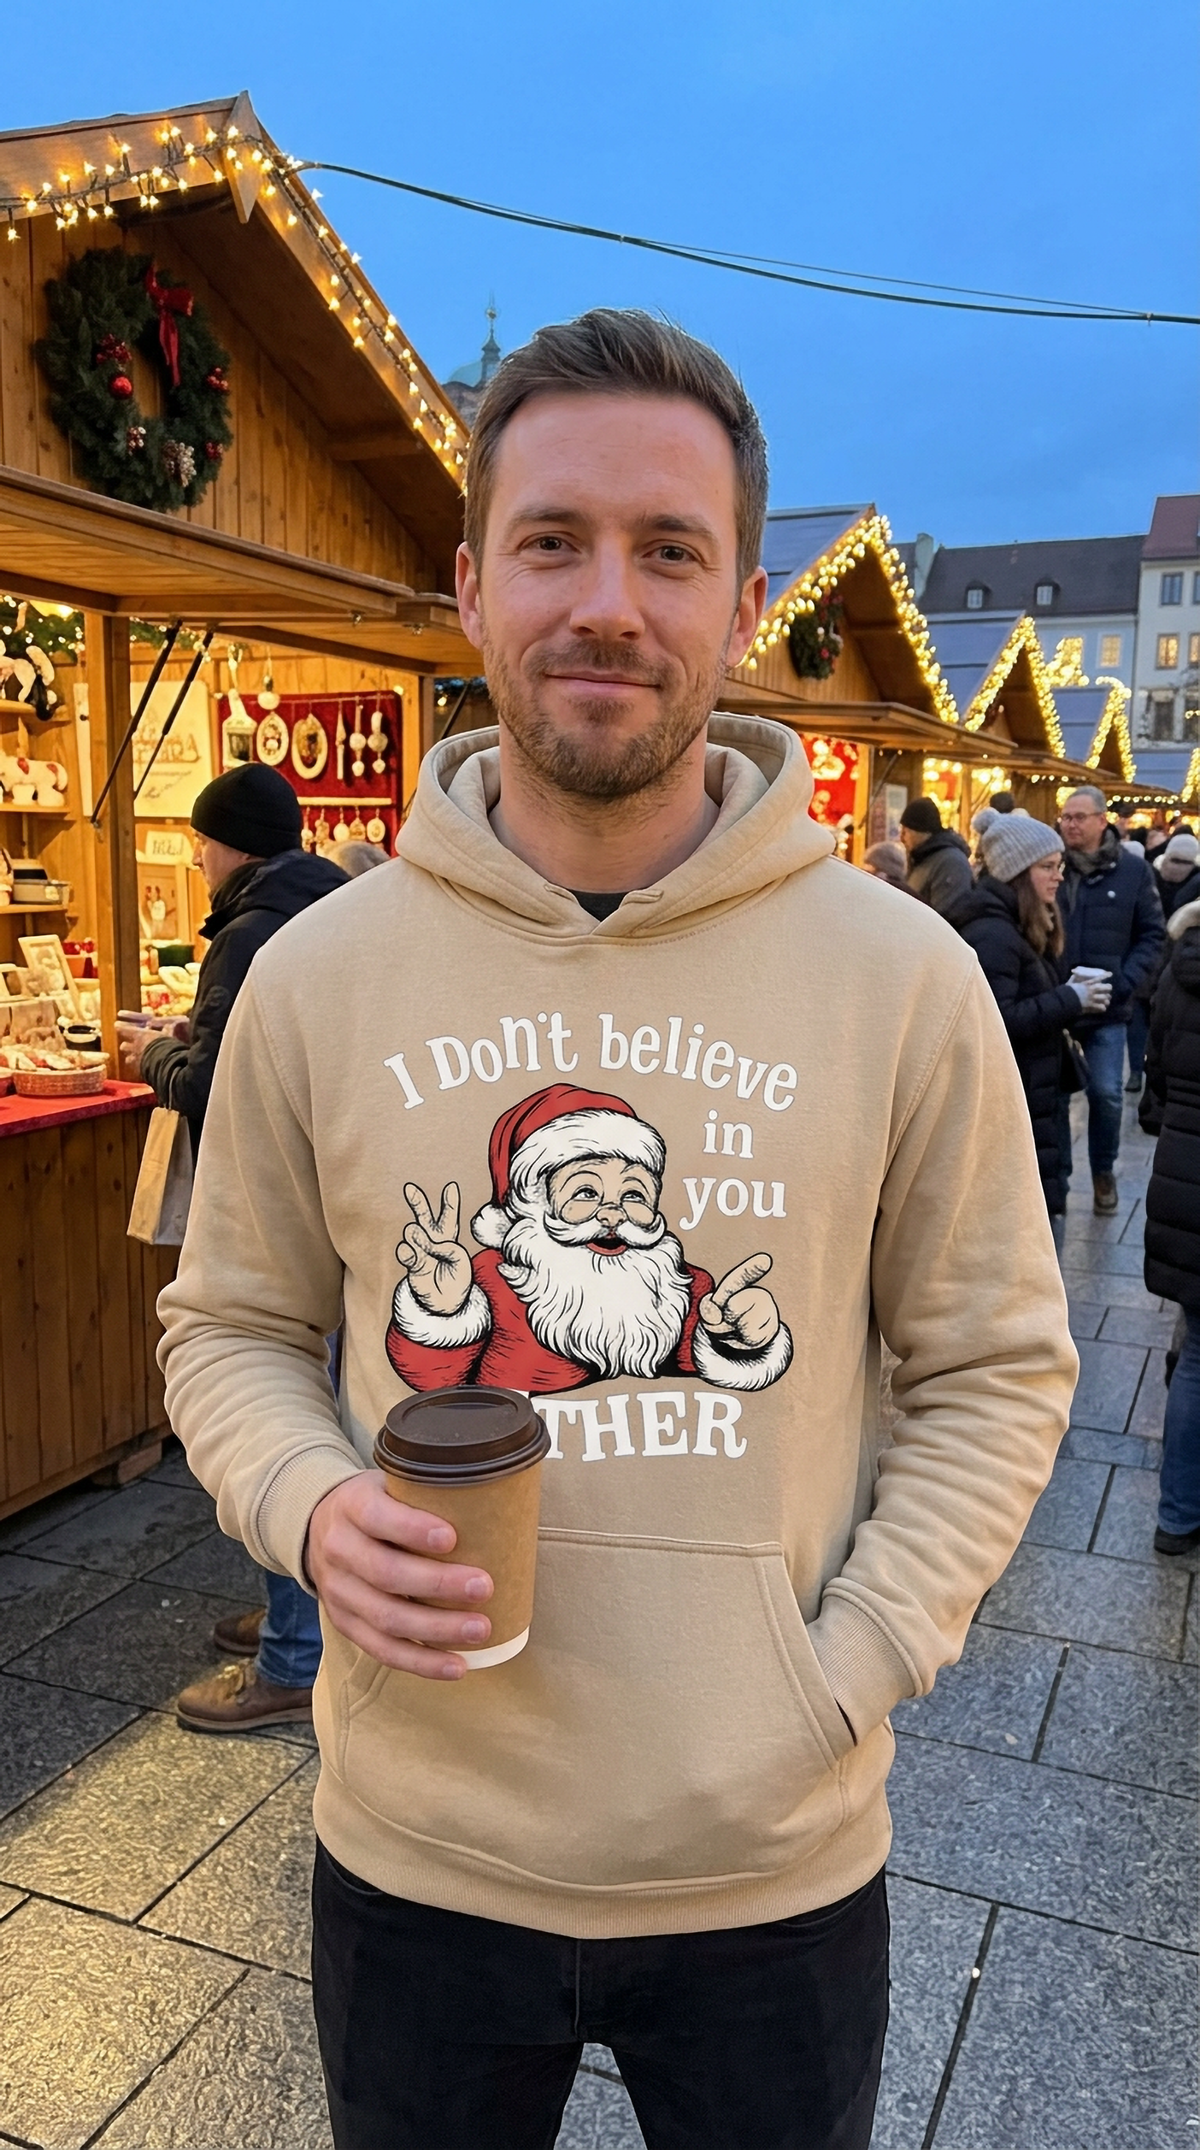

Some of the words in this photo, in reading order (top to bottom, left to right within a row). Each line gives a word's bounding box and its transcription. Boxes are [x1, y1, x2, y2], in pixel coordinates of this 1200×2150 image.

[383, 1052, 425, 1110] I
[425, 1012, 579, 1091] Don't
[598, 1012, 798, 1111] believe
[702, 1109, 754, 1159] in
[678, 1176, 787, 1231] you
[530, 1391, 748, 1462] THER
